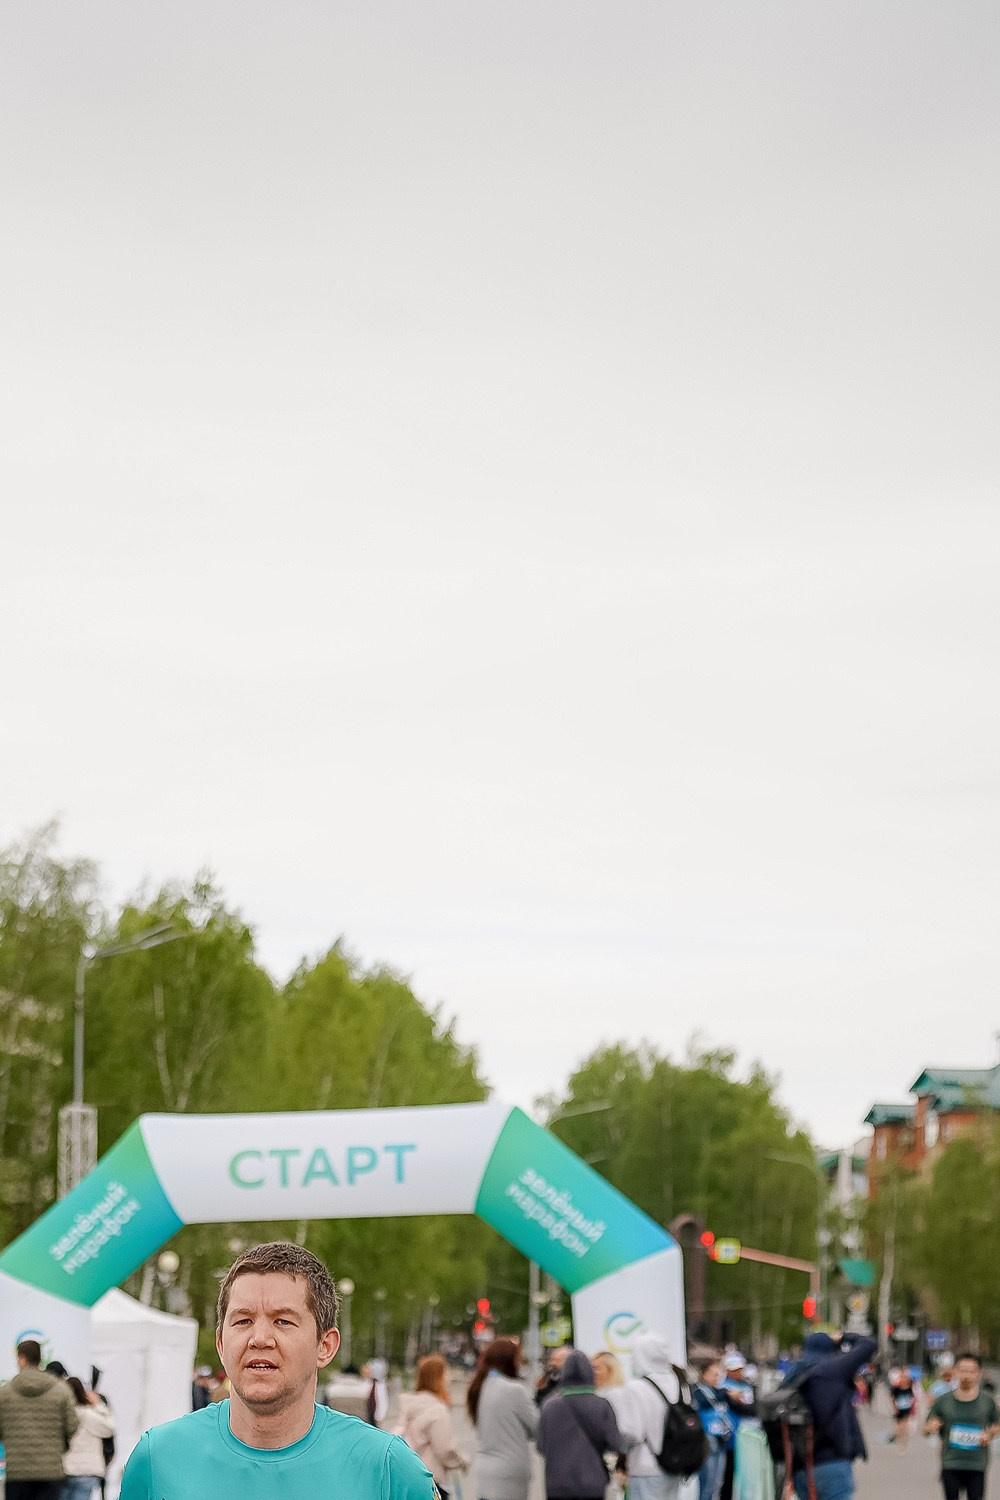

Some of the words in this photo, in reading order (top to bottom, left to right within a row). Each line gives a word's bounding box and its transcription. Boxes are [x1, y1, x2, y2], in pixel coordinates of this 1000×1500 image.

[228, 1144, 416, 1190] СТАРТ
[505, 1184, 590, 1258] марафон
[519, 1168, 606, 1243] зелёный
